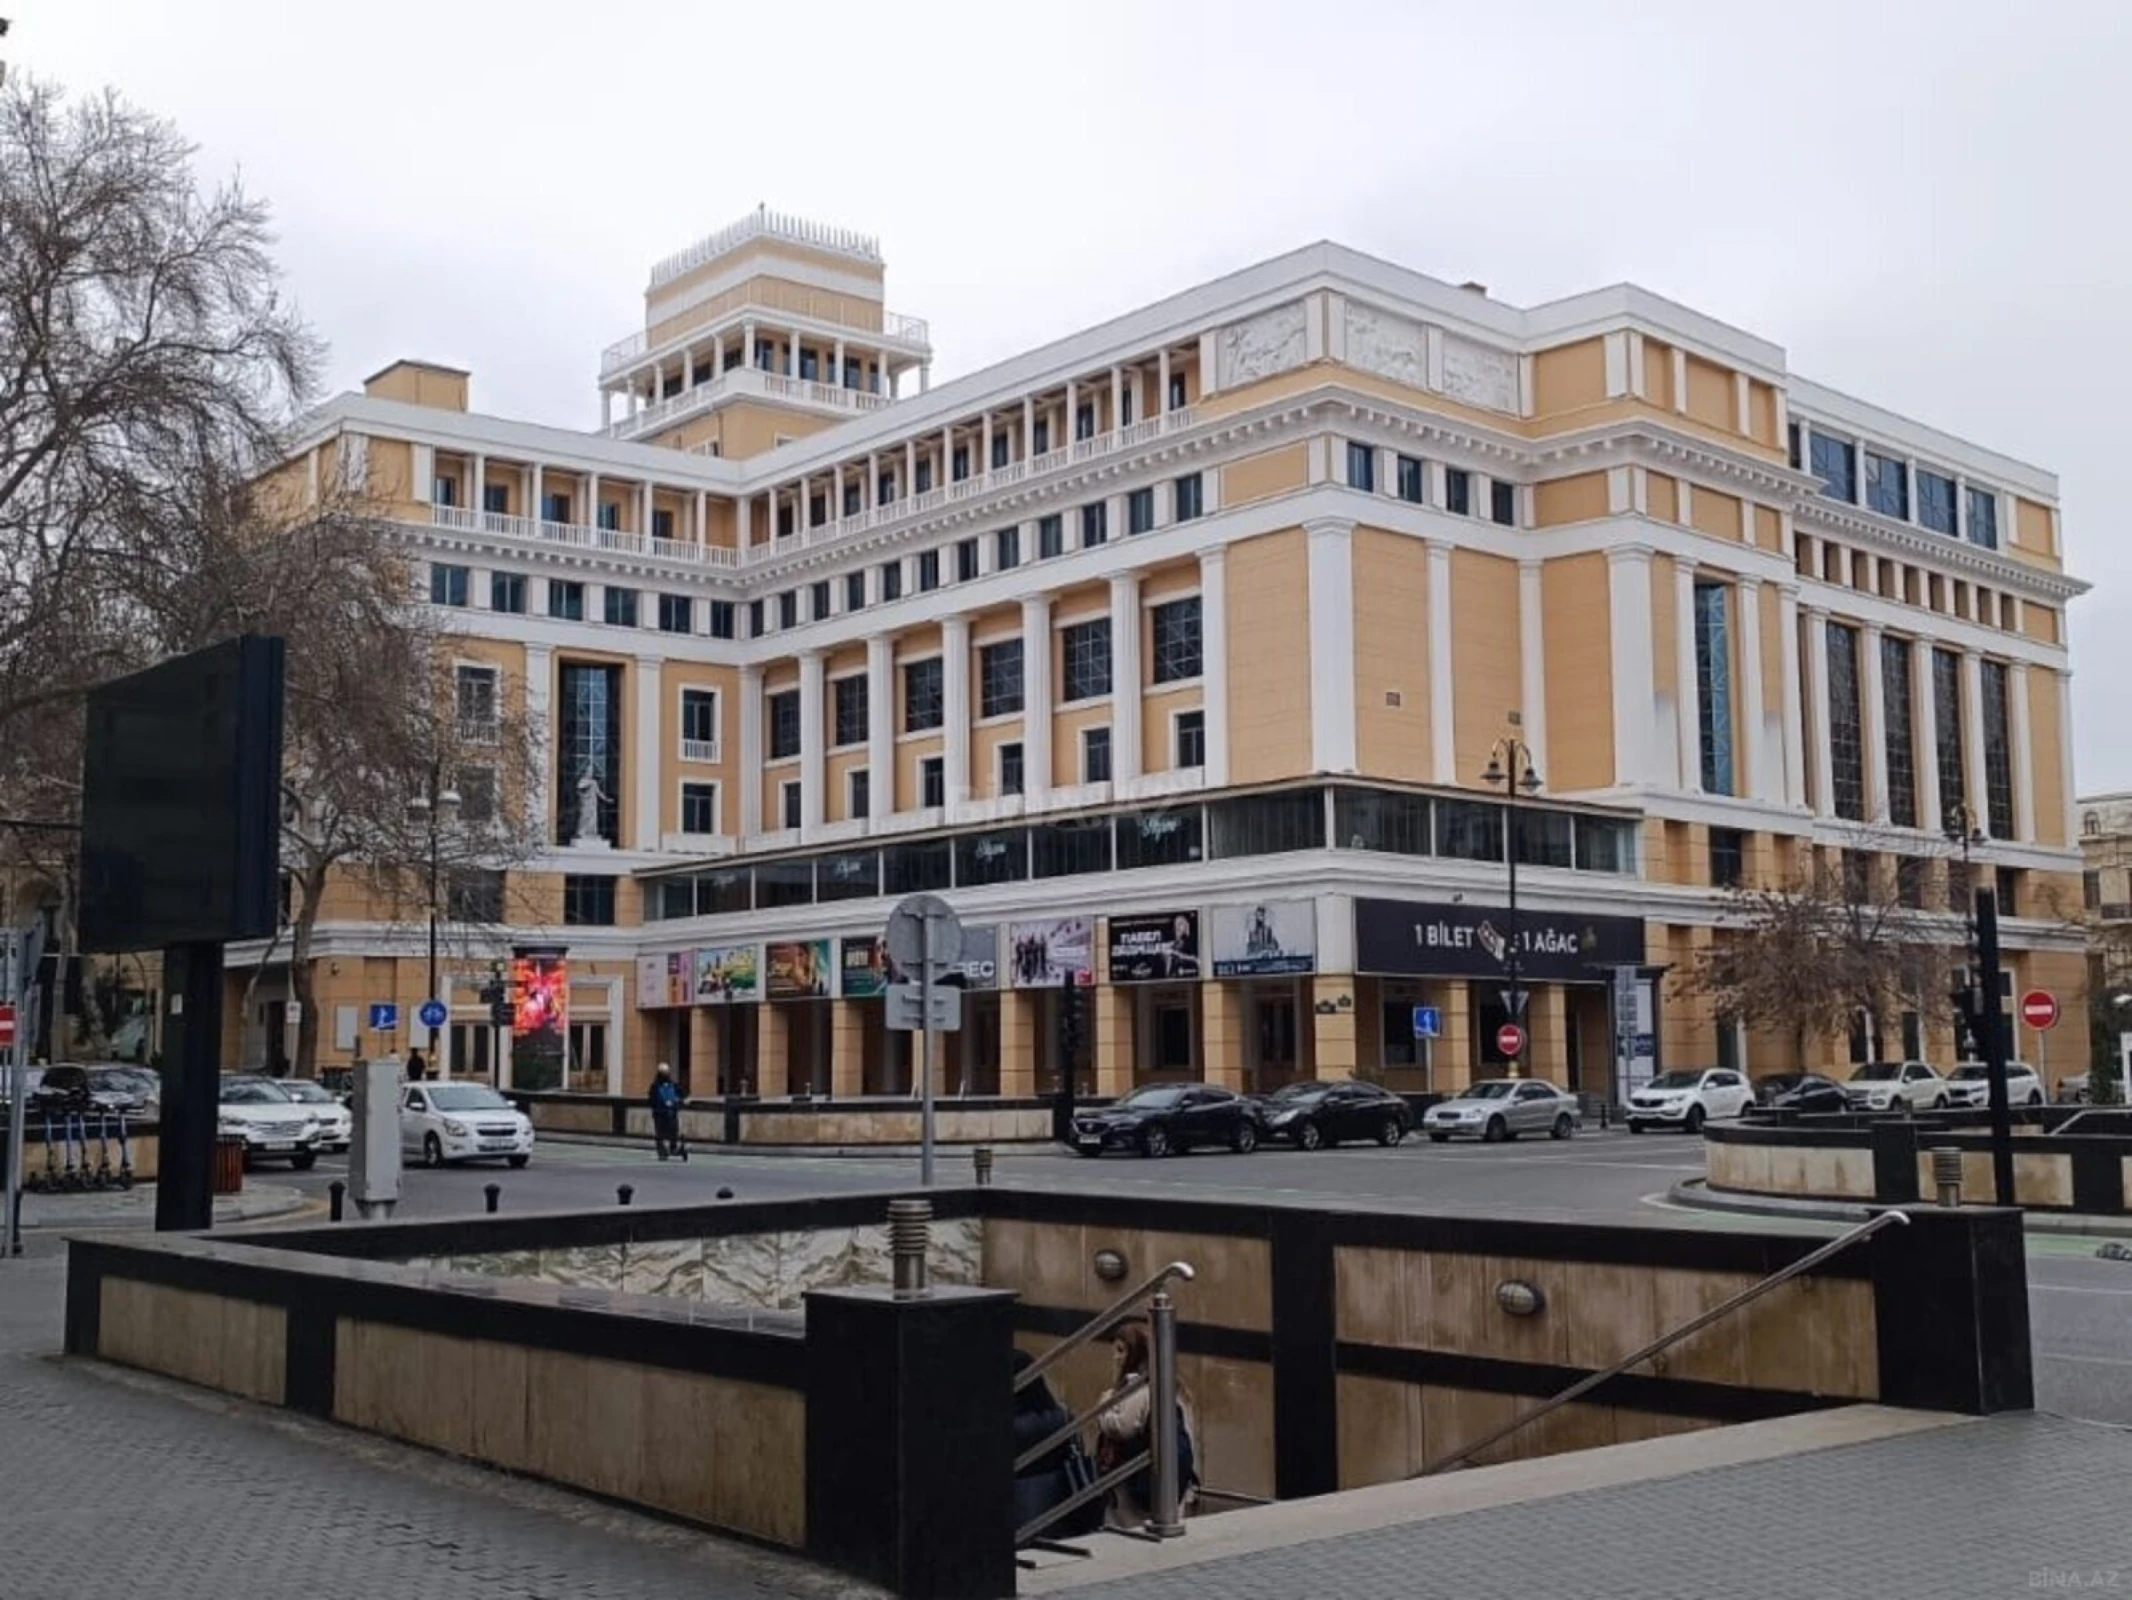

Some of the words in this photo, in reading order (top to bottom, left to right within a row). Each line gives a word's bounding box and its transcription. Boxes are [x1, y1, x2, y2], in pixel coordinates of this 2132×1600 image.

[1414, 924, 1423, 946] 1
[1426, 920, 1474, 948] BİLET
[1522, 931, 1531, 951] 1
[1534, 928, 1578, 953] AĞAC
